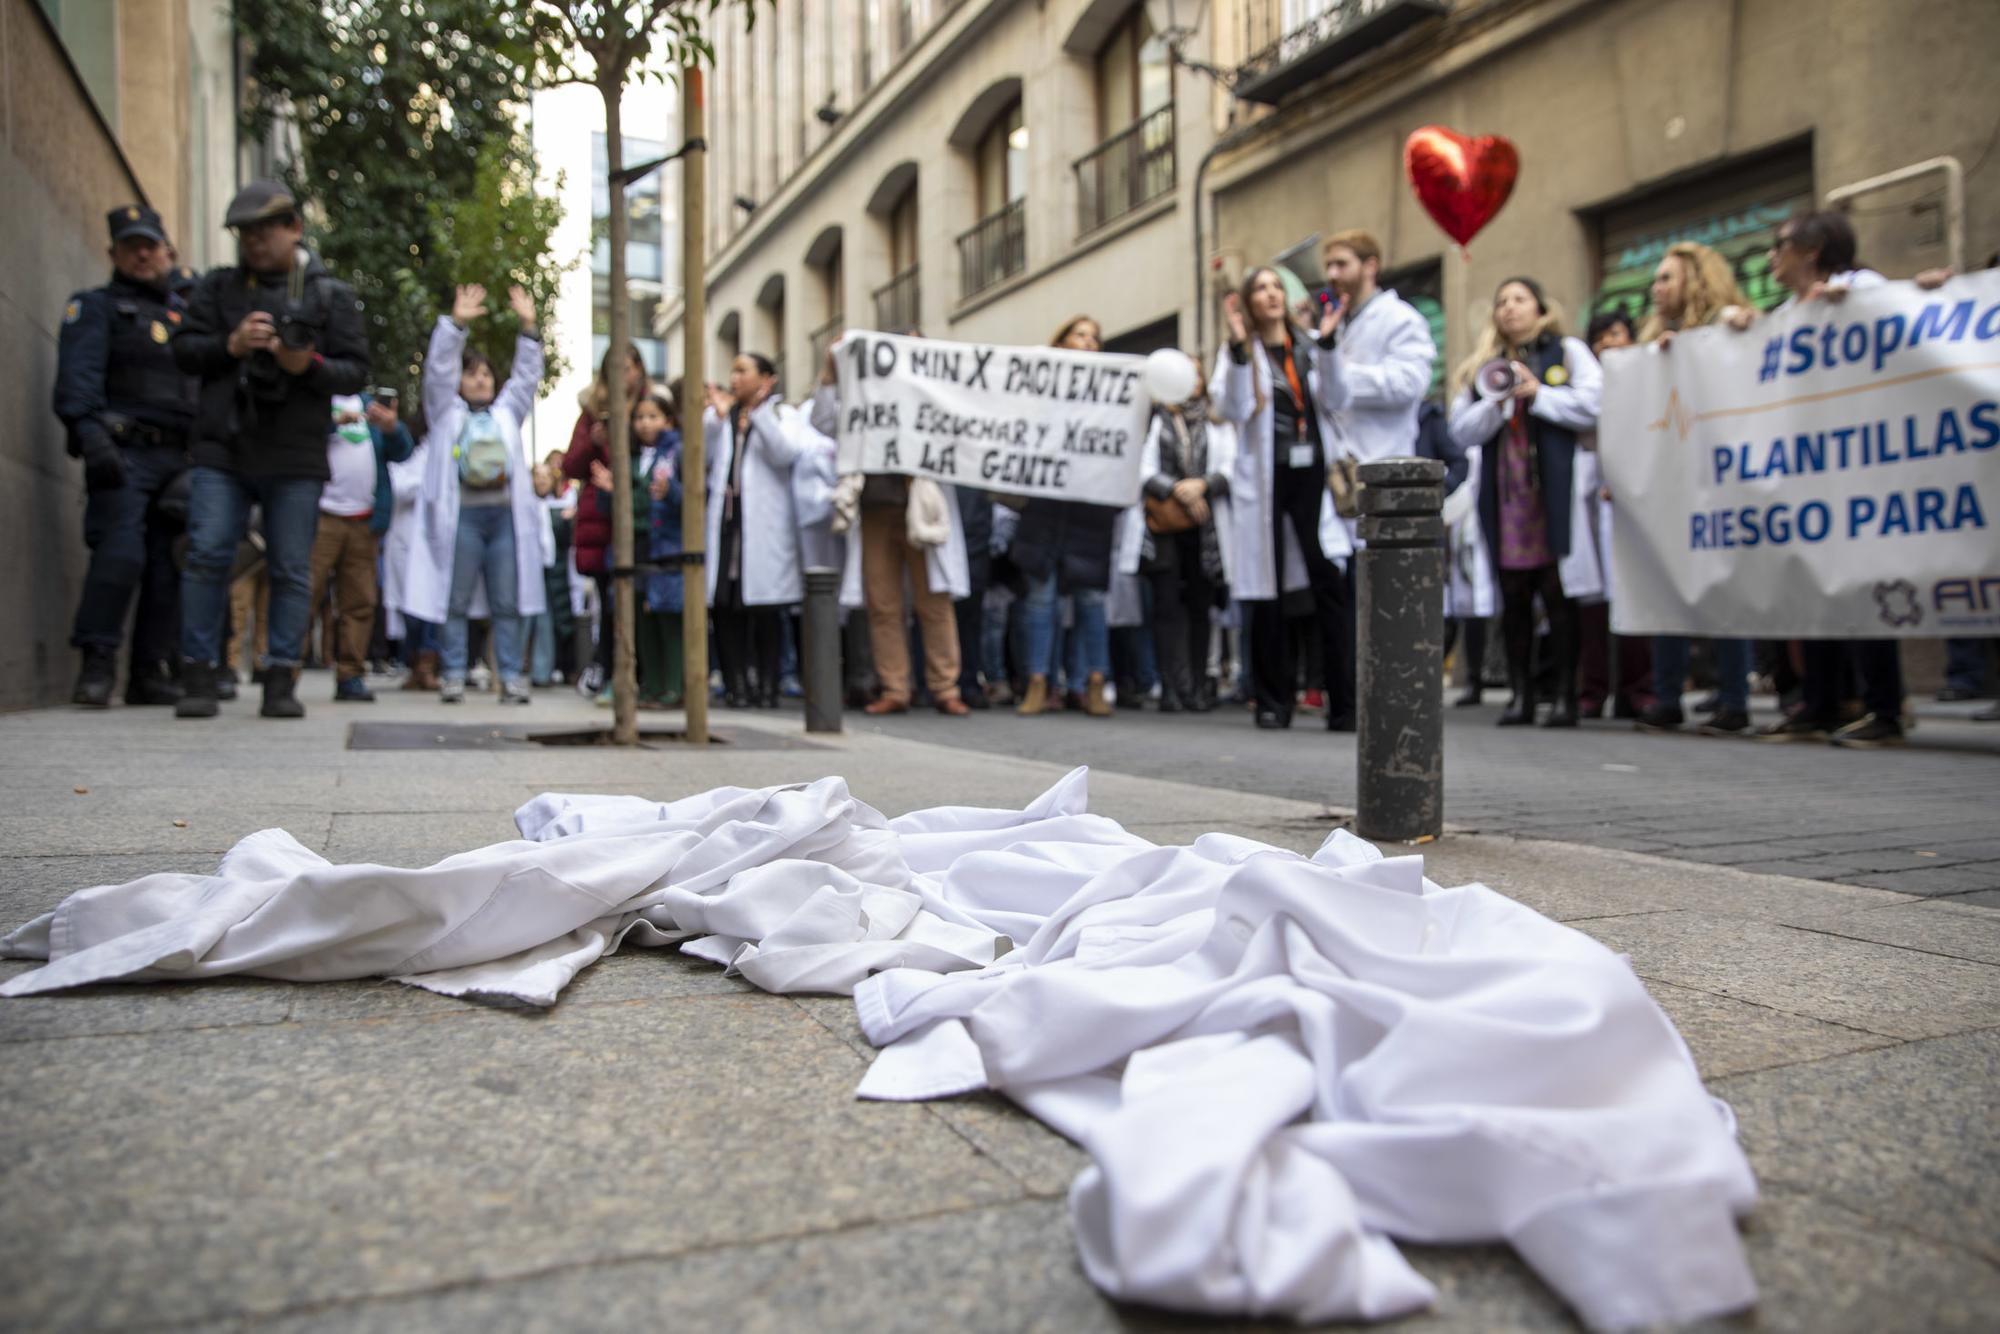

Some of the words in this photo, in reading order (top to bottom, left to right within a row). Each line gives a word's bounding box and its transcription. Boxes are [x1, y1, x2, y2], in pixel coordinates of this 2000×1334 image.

[849, 338, 896, 381] 10
[911, 350, 960, 382] MIN
[966, 348, 993, 391] X
[848, 403, 900, 433] PARA
[1713, 401, 2000, 486] PLANTILLAS
[884, 438, 900, 467] A
[919, 443, 957, 475] LA
[981, 450, 1069, 489] GENTE
[1690, 501, 1832, 552] RIESGO
[1847, 482, 1987, 541] PARA
